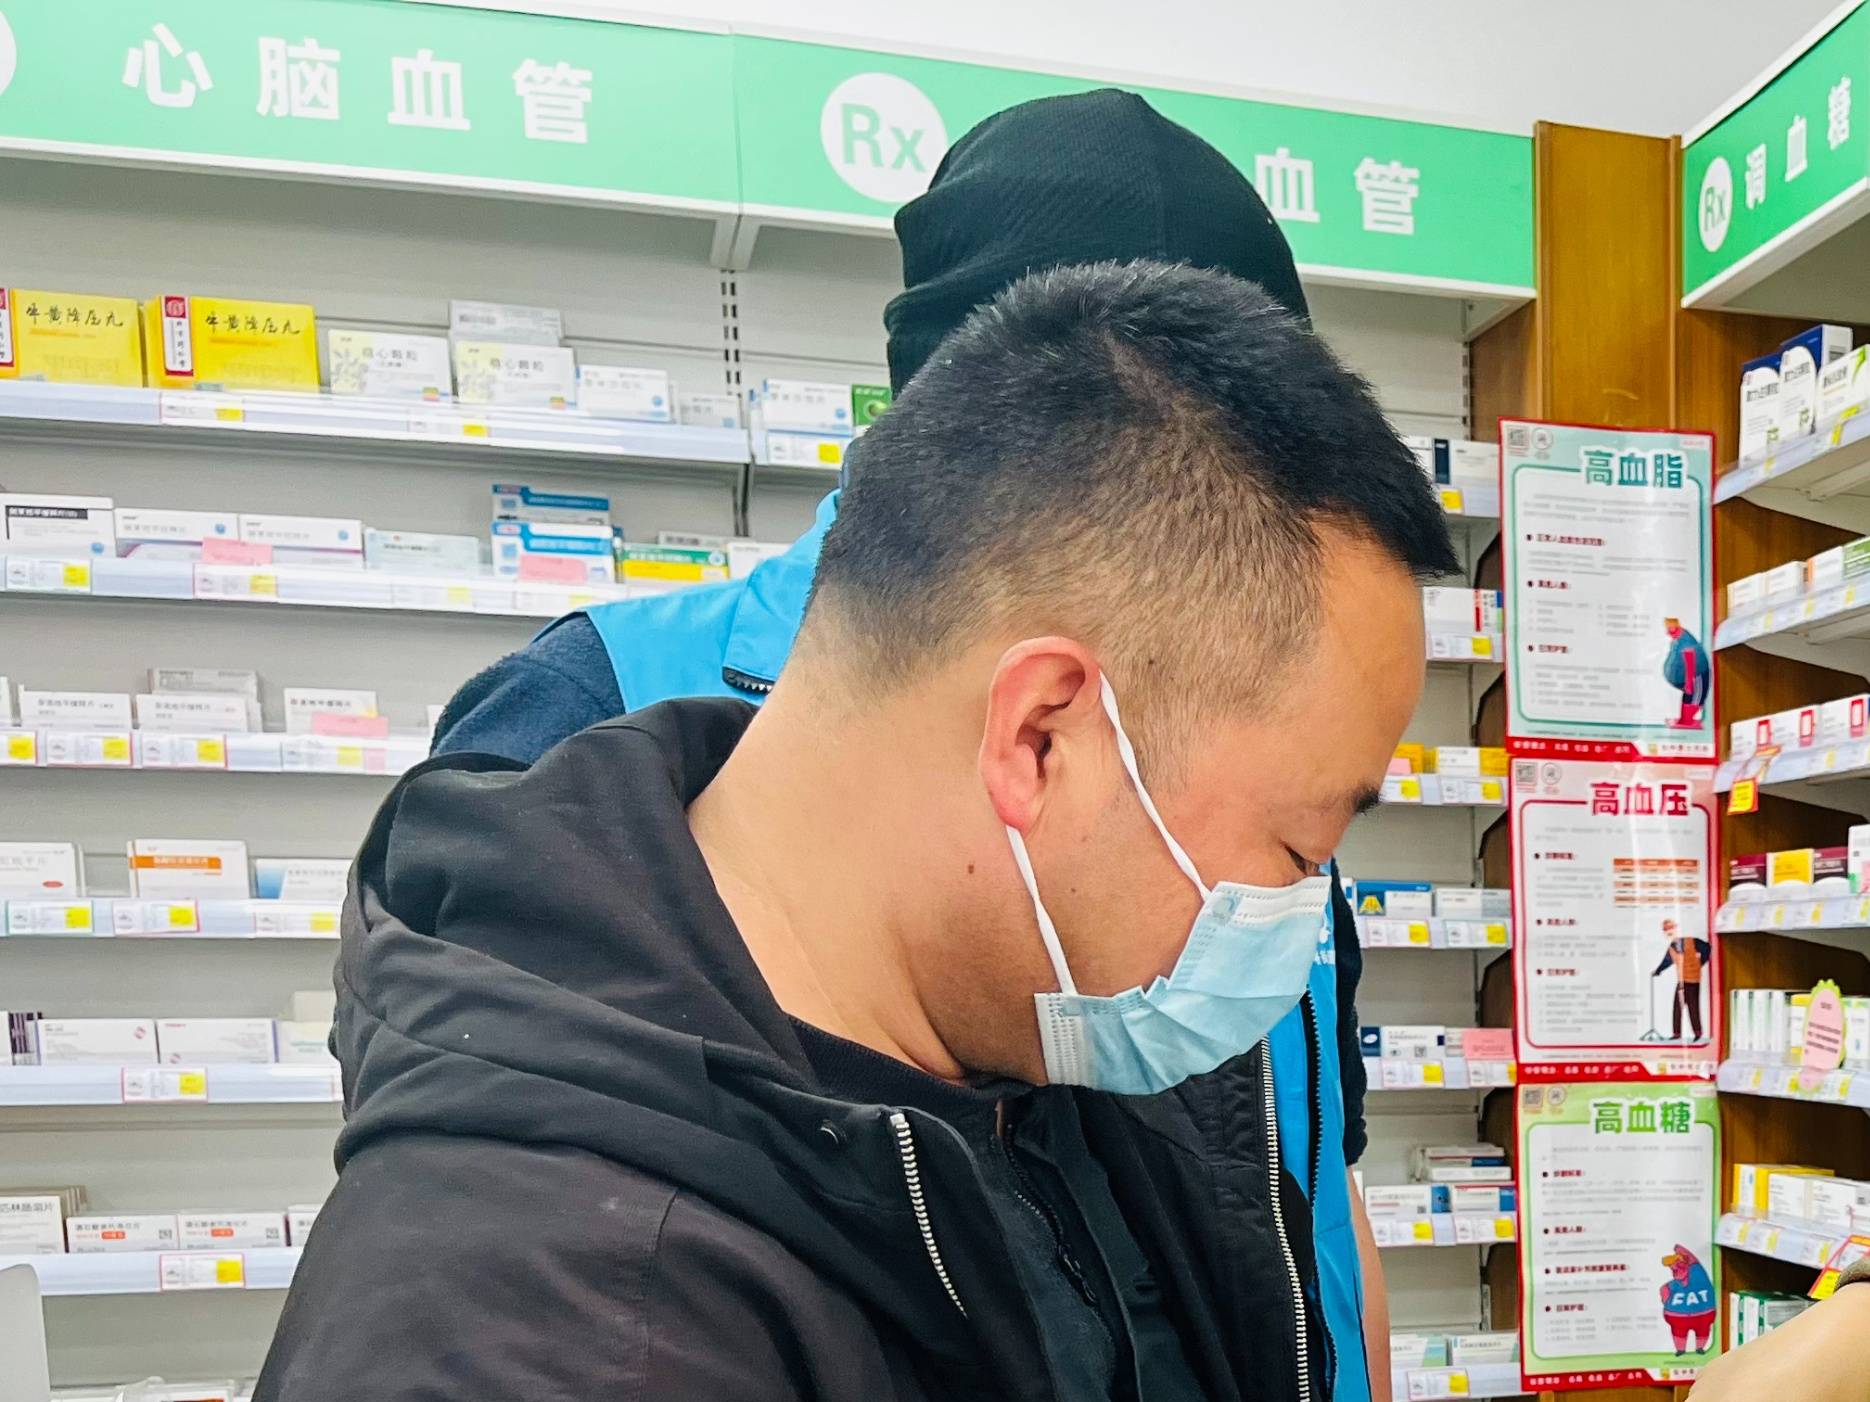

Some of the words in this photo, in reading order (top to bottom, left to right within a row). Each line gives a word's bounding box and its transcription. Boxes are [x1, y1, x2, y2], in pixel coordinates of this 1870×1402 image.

[122, 23, 594, 144] 心脑血管
[841, 104, 927, 175] Rx
[1745, 76, 1852, 210] 调血糖
[1704, 187, 1727, 232] Rx
[1584, 450, 1682, 489] 高血脂
[1590, 783, 1689, 816] 高血压
[1593, 1102, 1691, 1134] 高血糖
[1672, 1290, 1708, 1306] FAT
